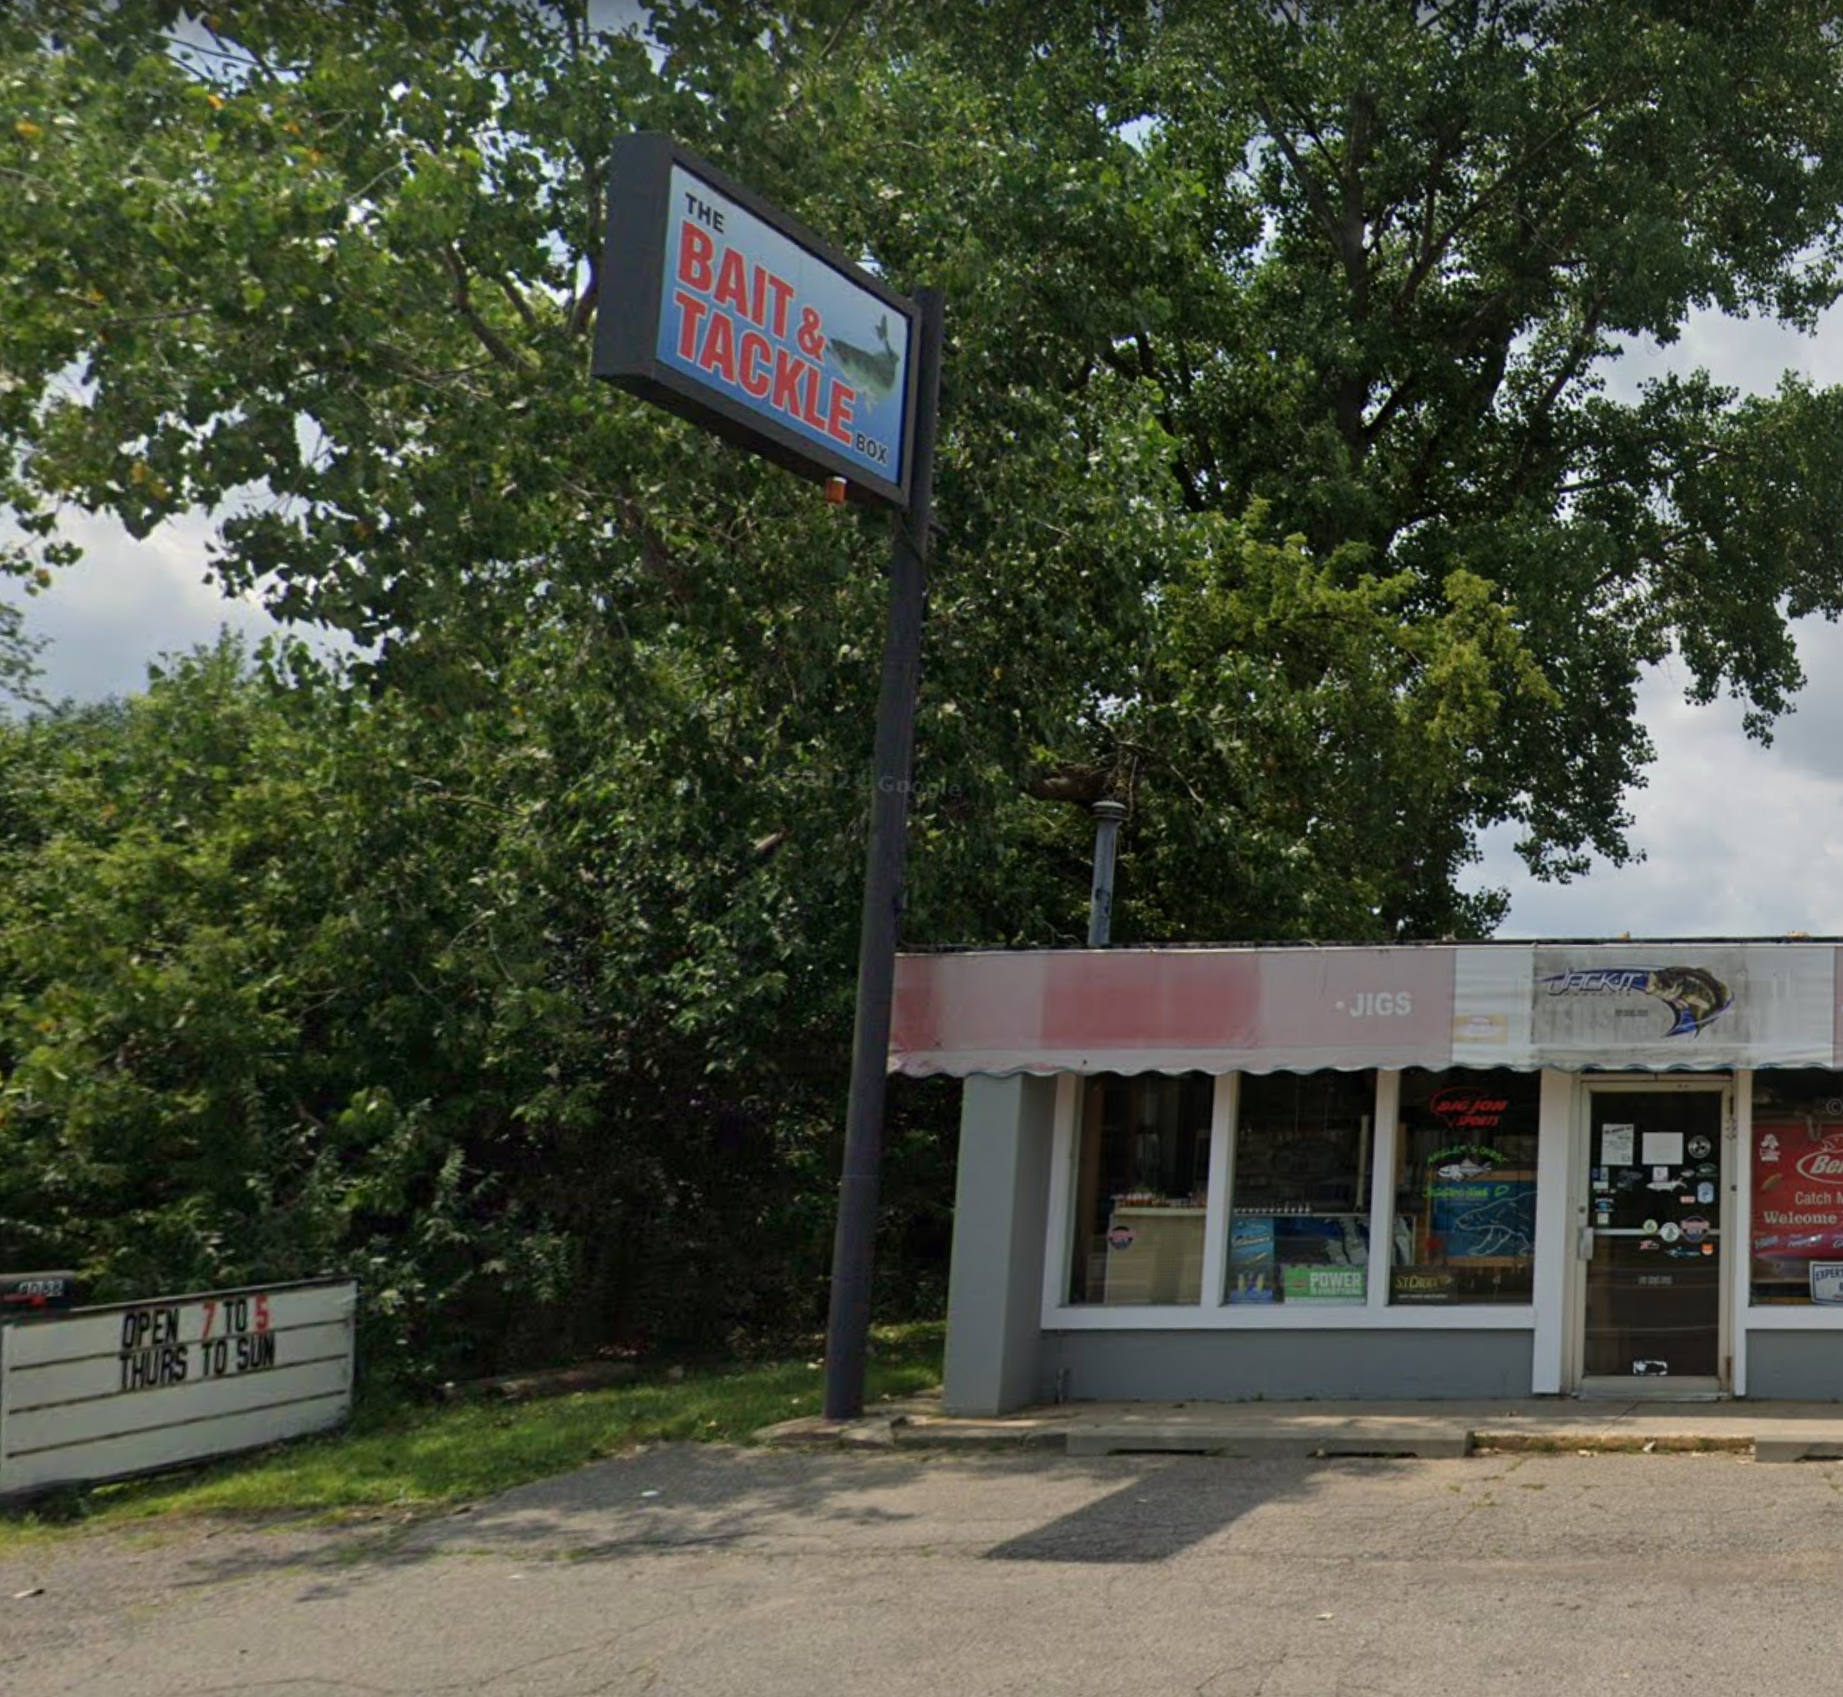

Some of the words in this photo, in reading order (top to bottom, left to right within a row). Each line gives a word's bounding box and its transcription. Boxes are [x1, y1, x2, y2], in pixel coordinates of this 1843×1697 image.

[685, 192, 724, 234] THE
[676, 220, 795, 340] BAIT
[796, 305, 828, 364] &
[673, 288, 857, 445] TACKLE
[856, 432, 888, 464] BOX
[1349, 991, 1412, 1018] JIGS
[1795, 1191, 1831, 1205] Catch
[1763, 1210, 1838, 1224] Welcome
[1310, 1272, 1362, 1287] POWER
[1815, 1268, 1843, 1281] EXPERT
[122, 1307, 179, 1349] OPEN
[200, 1303, 216, 1340] 7
[223, 1299, 248, 1334] TO
[255, 1295, 271, 1333] 5
[119, 1344, 188, 1390] THURS
[201, 1339, 228, 1377] TO
[237, 1332, 275, 1371] SUN
